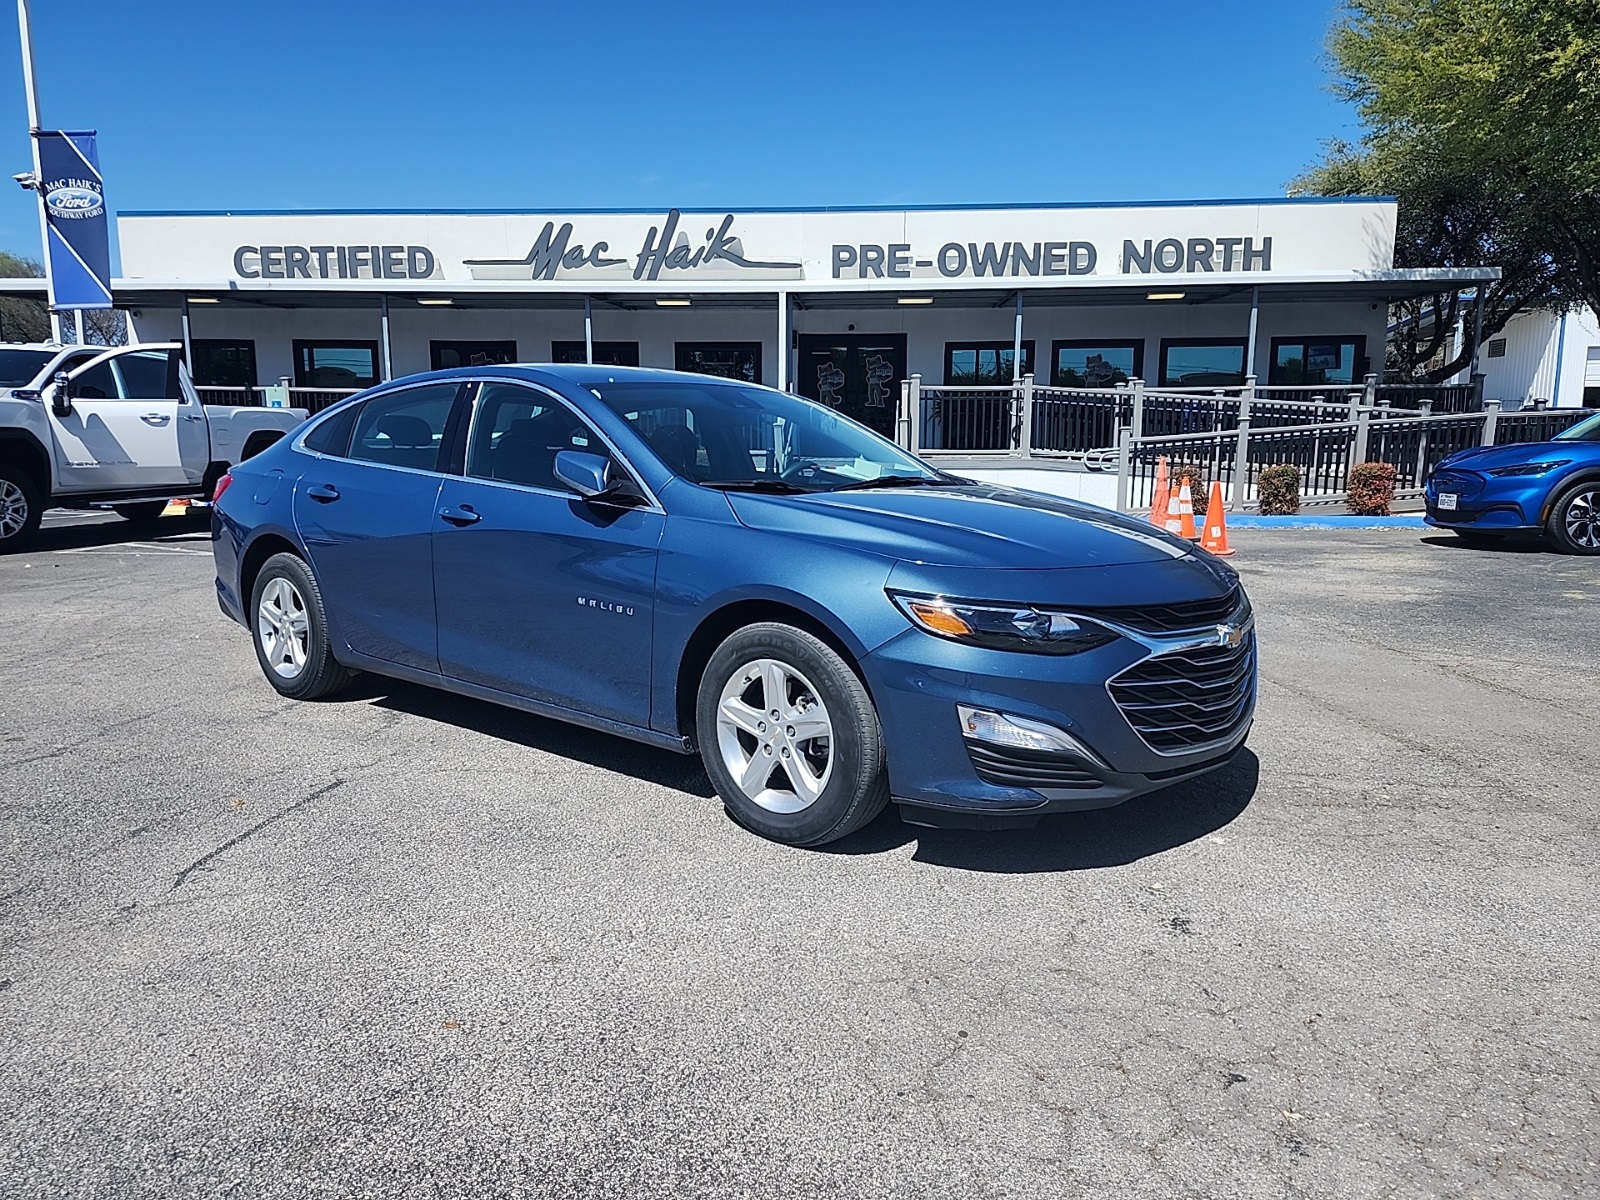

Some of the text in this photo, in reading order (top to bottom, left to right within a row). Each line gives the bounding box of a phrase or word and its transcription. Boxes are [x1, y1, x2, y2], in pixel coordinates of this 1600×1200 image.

[45, 178, 102, 193] MAC HAIK'S
[56, 192, 91, 208] Ford
[49, 207, 104, 219] SOUTHWAY FORD
[463, 208, 802, 281] Mac Haik
[233, 245, 435, 279] CERTIFIED
[832, 236, 1273, 279] PRE-OWNED NORTH
[577, 597, 634, 616] MALIBU
